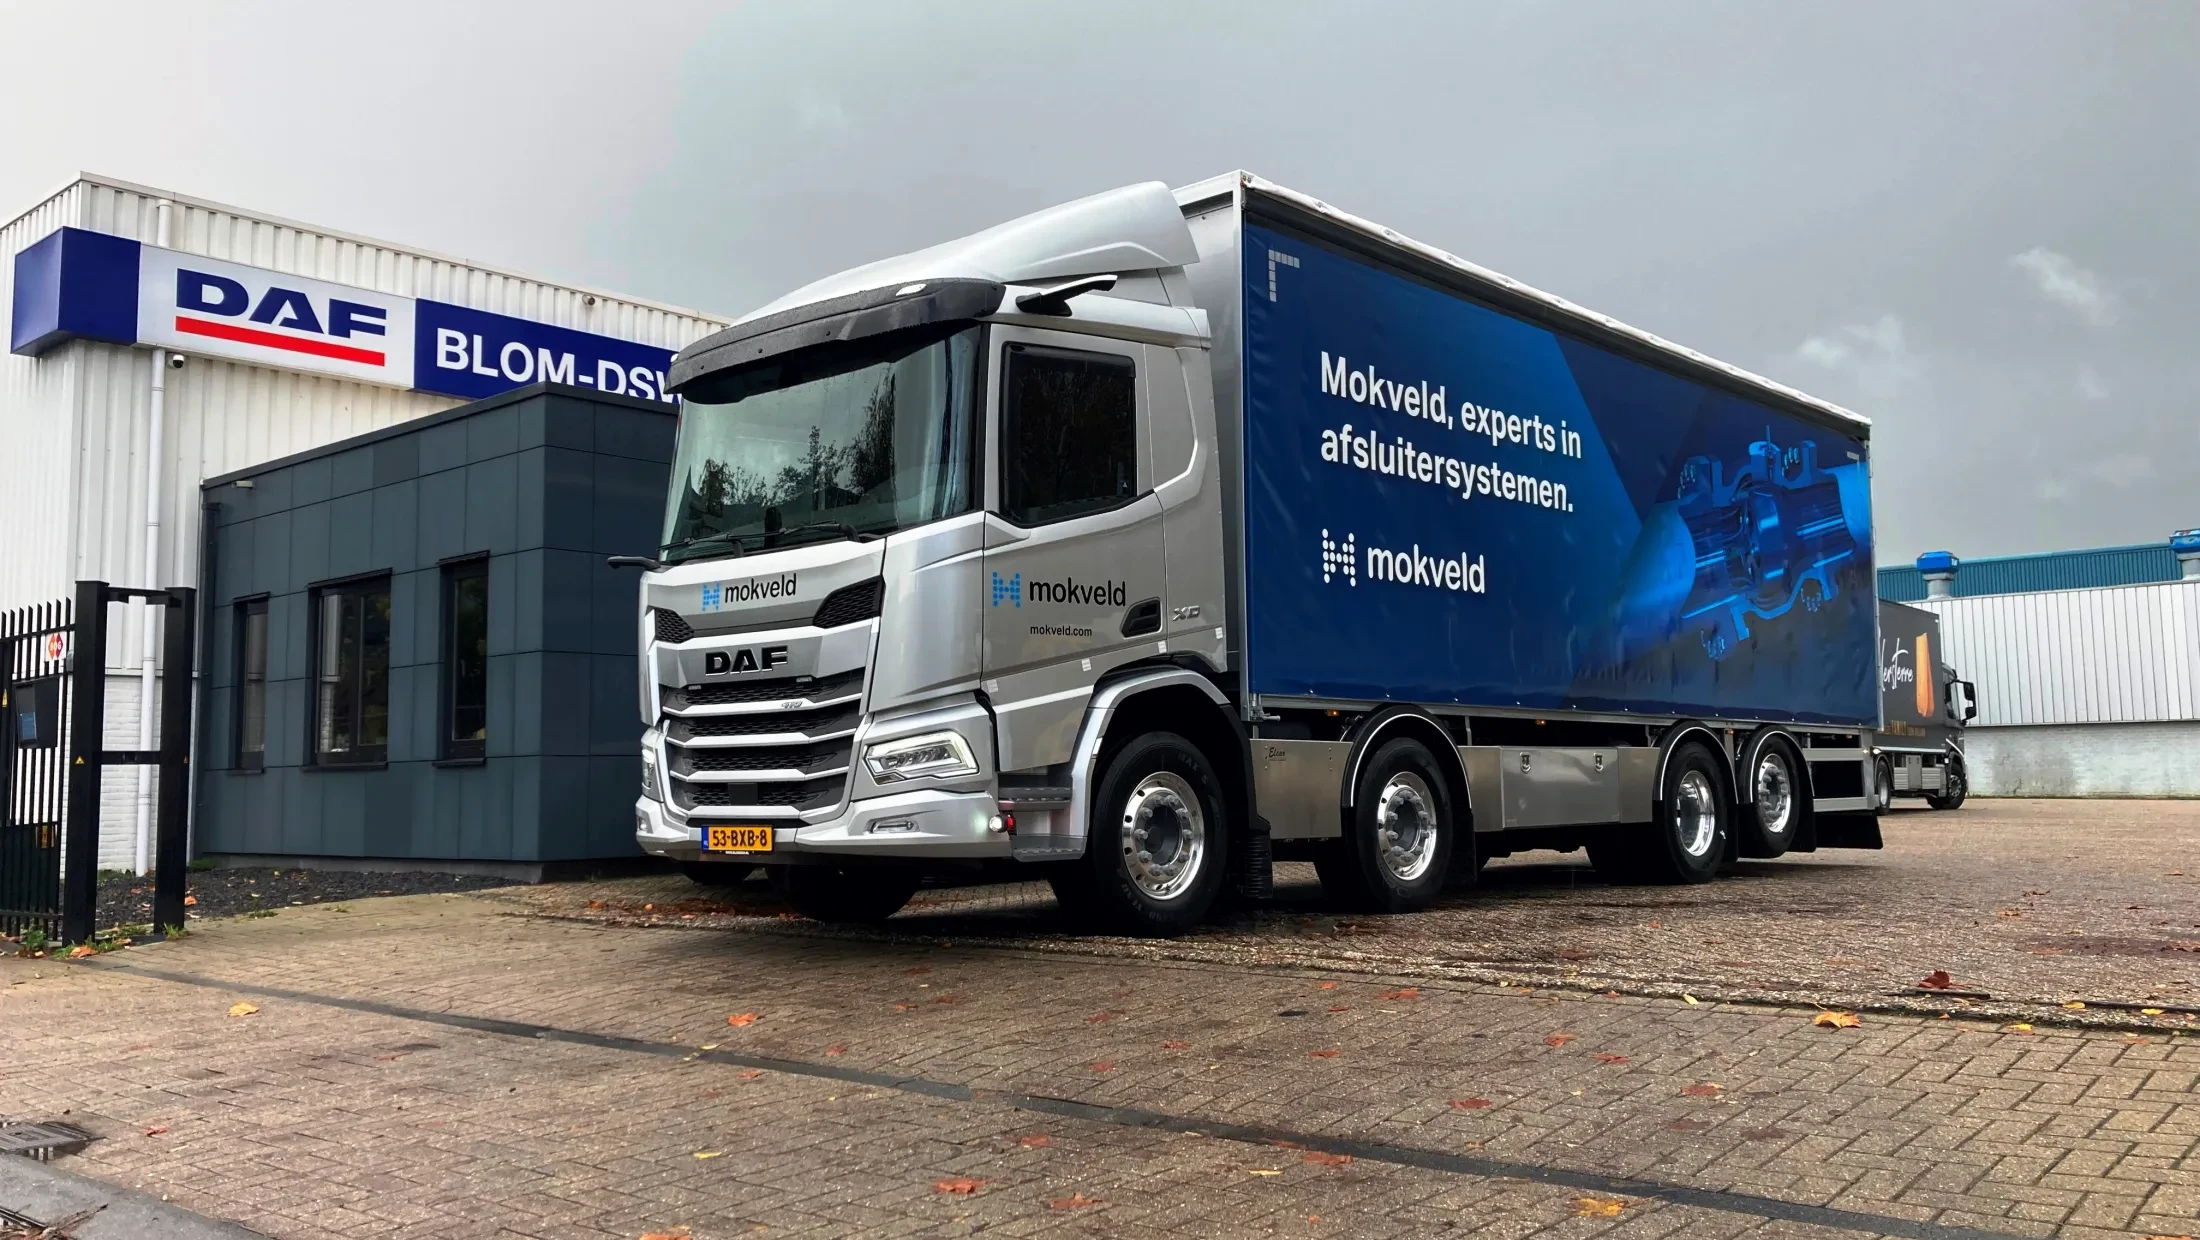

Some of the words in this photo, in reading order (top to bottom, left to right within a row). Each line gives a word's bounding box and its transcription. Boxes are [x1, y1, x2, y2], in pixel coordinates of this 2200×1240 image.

[176, 268, 387, 338] DAF
[1320, 350, 1454, 430] Mokveld,
[1461, 401, 1556, 452] experts
[1561, 419, 1582, 459] in
[1320, 423, 1574, 513] afsluitersystemen.
[1367, 543, 1485, 594] mokveld
[724, 572, 797, 603] mokveld
[1029, 576, 1126, 607] mokveld
[1029, 624, 1093, 637] mokveld.com
[705, 644, 788, 676] DAF
[712, 829, 768, 847] 53-BXB-8
